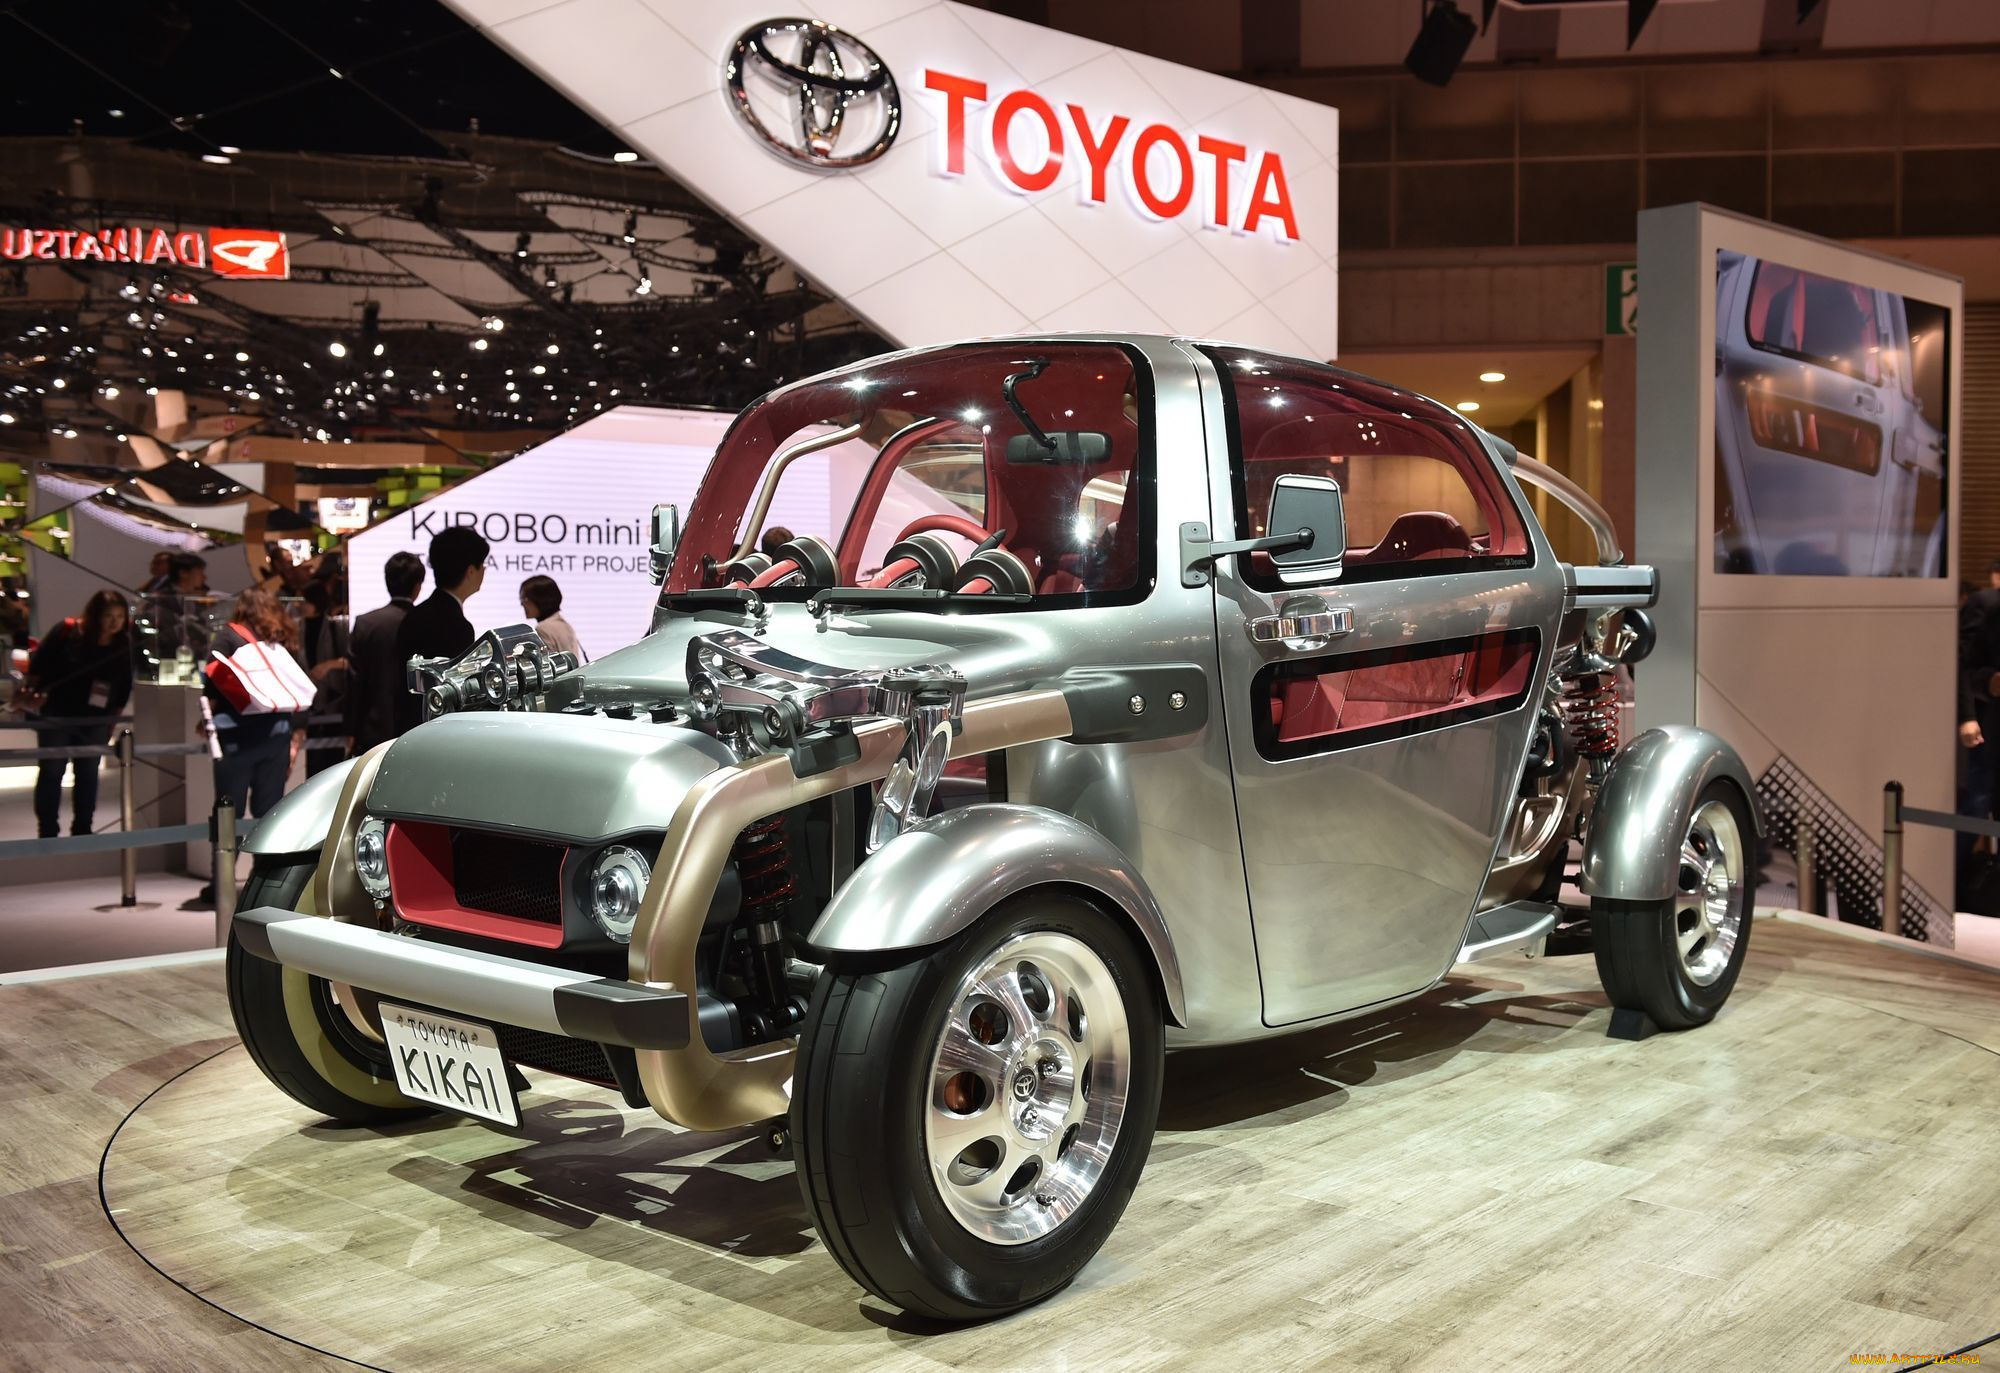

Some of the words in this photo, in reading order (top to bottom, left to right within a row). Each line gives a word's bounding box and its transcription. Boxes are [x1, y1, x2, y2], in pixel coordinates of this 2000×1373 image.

[922, 68, 1301, 242] TOYOTA
[575, 517, 641, 545] mini
[505, 554, 577, 572] HEART
[583, 554, 651, 573] PROJE
[407, 1018, 472, 1053] TOYOTA
[399, 1044, 502, 1114] KIKAI
